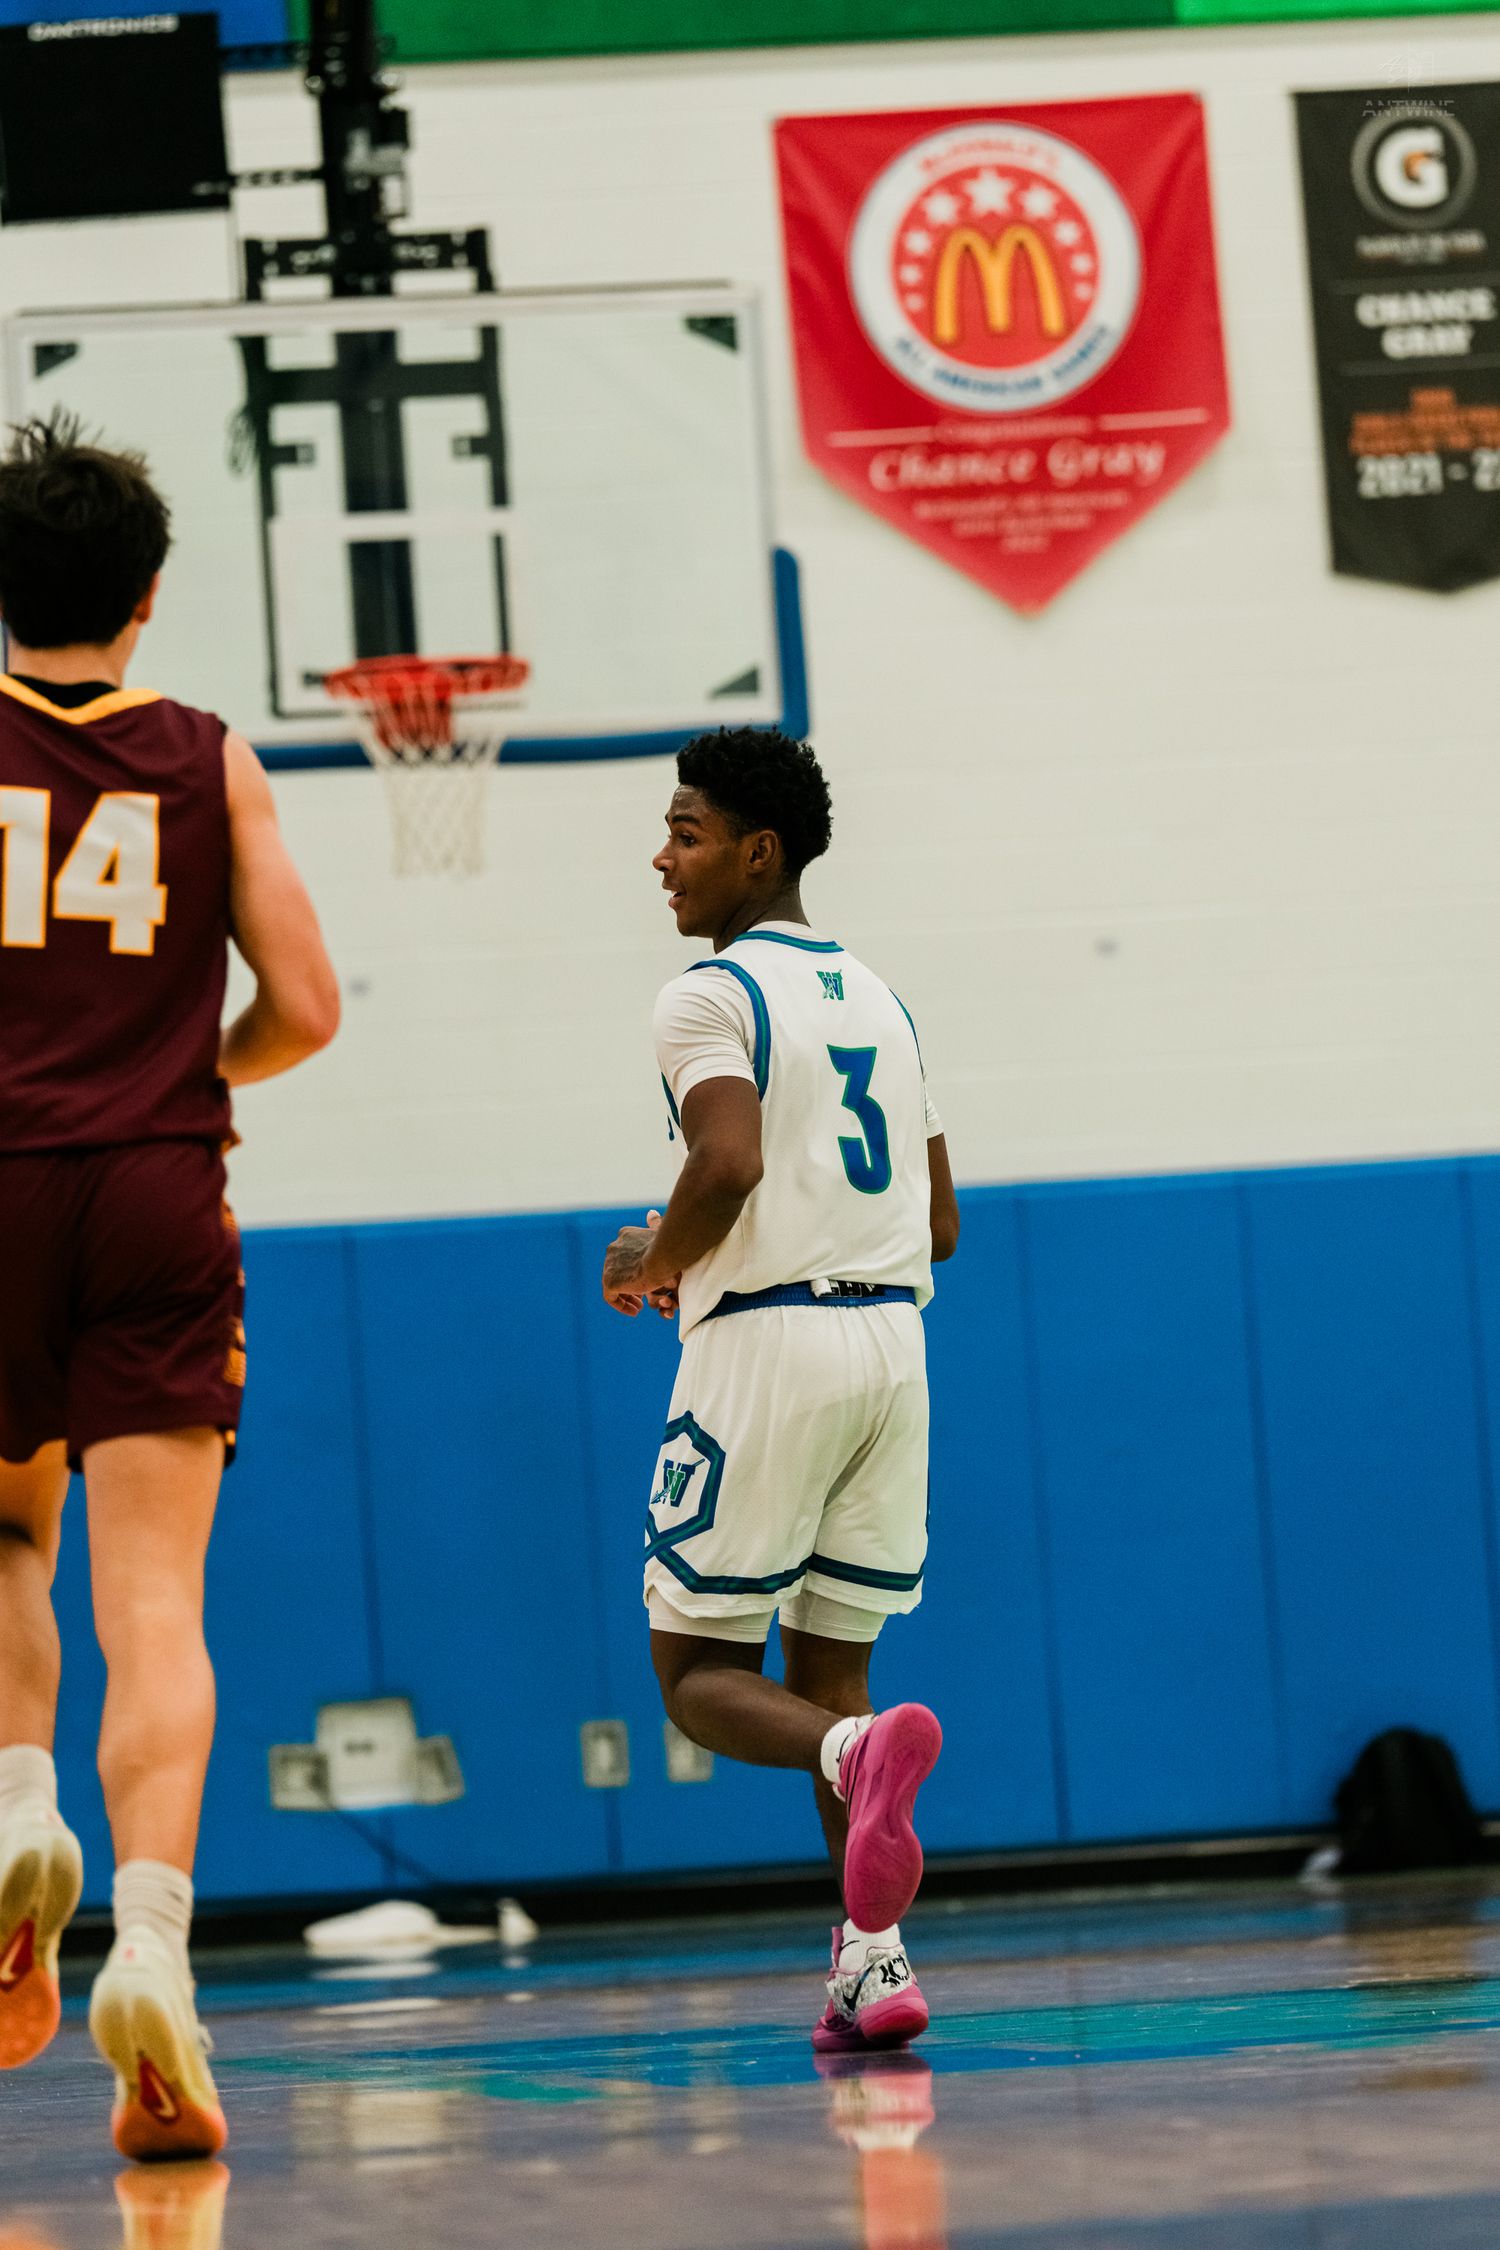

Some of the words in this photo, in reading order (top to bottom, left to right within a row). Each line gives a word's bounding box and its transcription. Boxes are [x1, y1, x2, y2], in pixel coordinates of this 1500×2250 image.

[1374, 126, 1450, 208] G
[868, 445, 1037, 492] Chance
[0, 785, 168, 956] 14
[826, 1043, 893, 1195] 3
